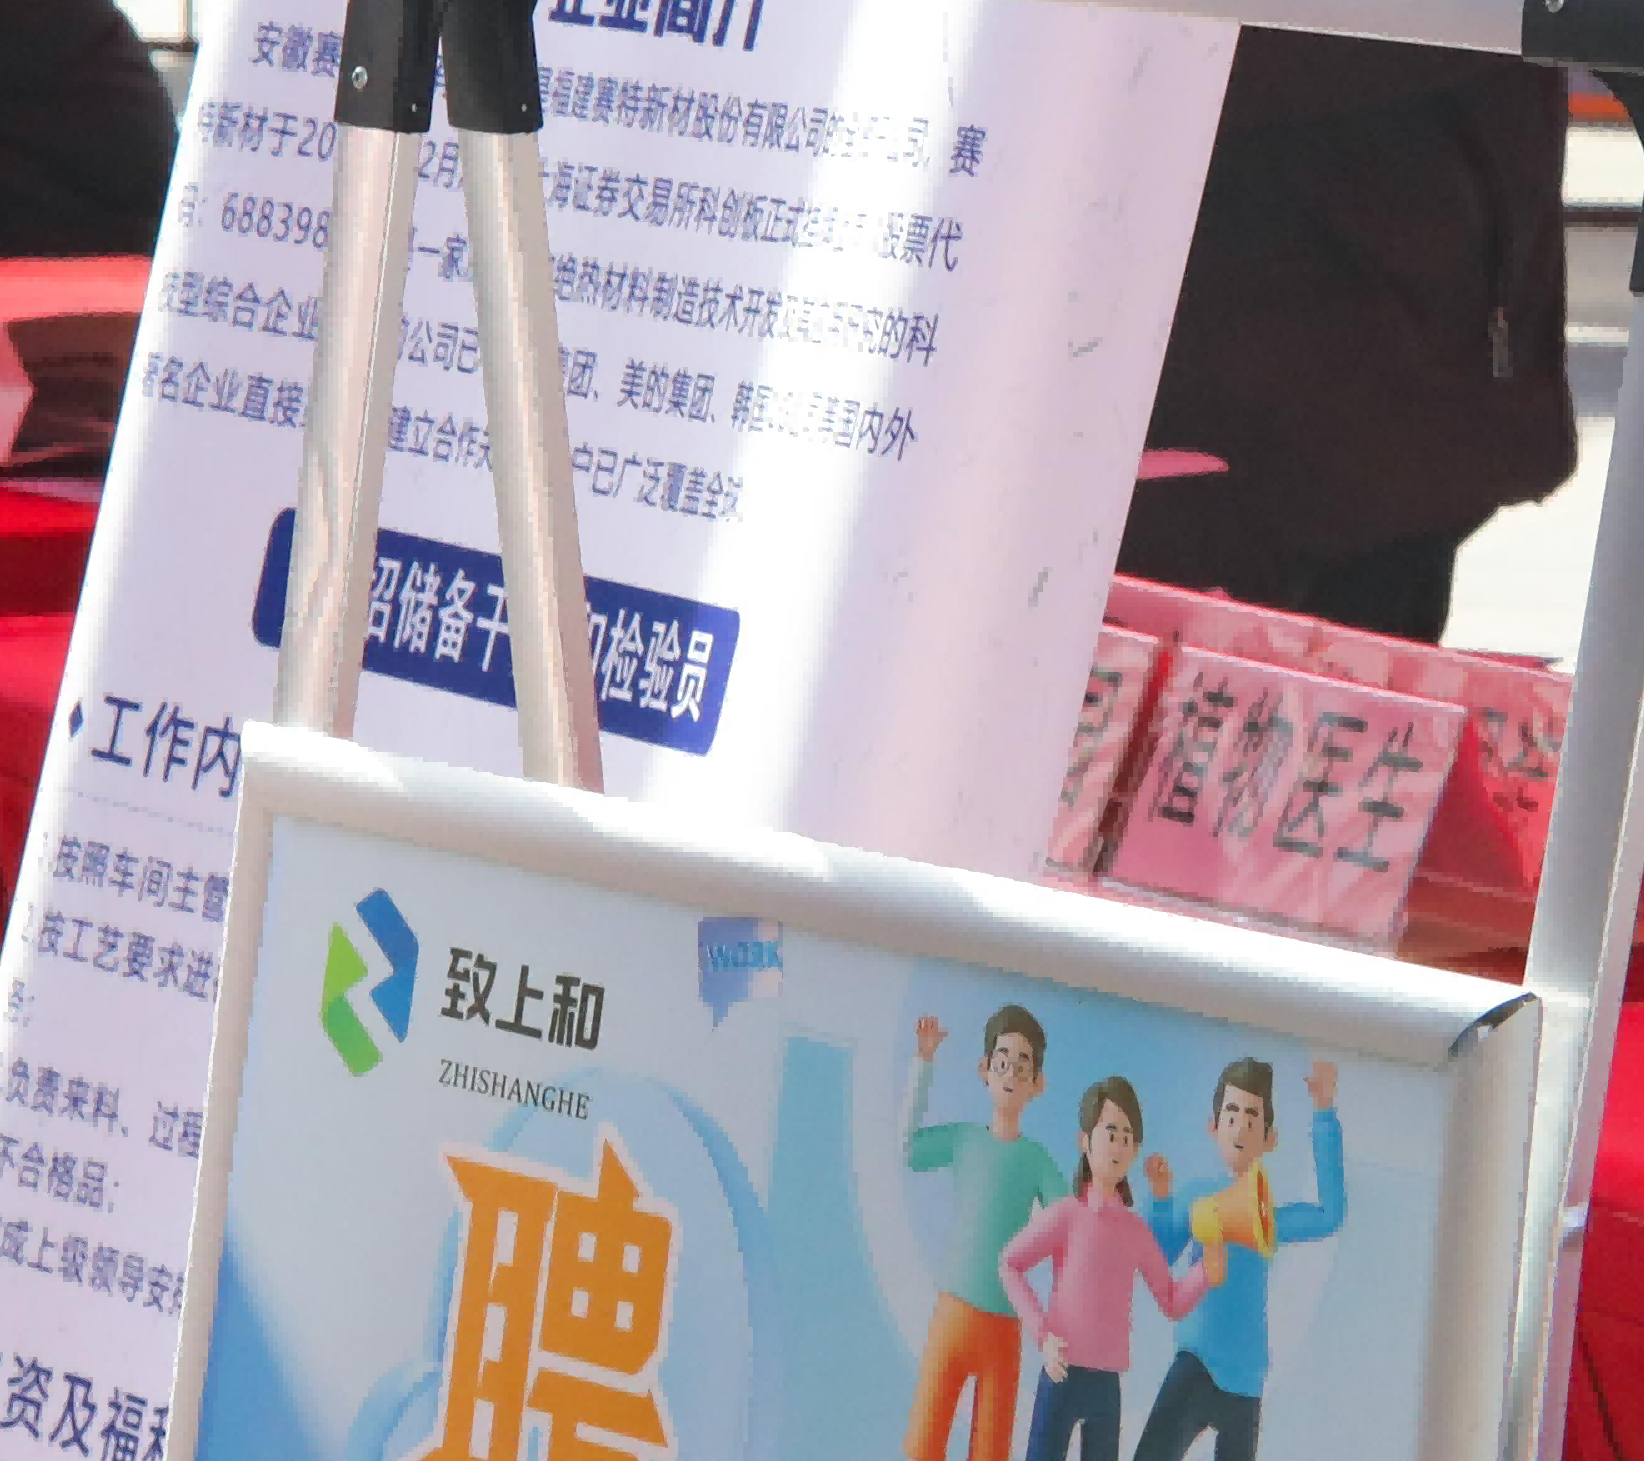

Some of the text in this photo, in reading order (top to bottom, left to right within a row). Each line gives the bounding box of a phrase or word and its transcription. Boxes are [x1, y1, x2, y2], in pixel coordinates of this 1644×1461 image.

[86, 694, 242, 799] 工作内
[439, 945, 606, 1051] 致上和
[437, 1057, 594, 1121] ZHISHANGHE
